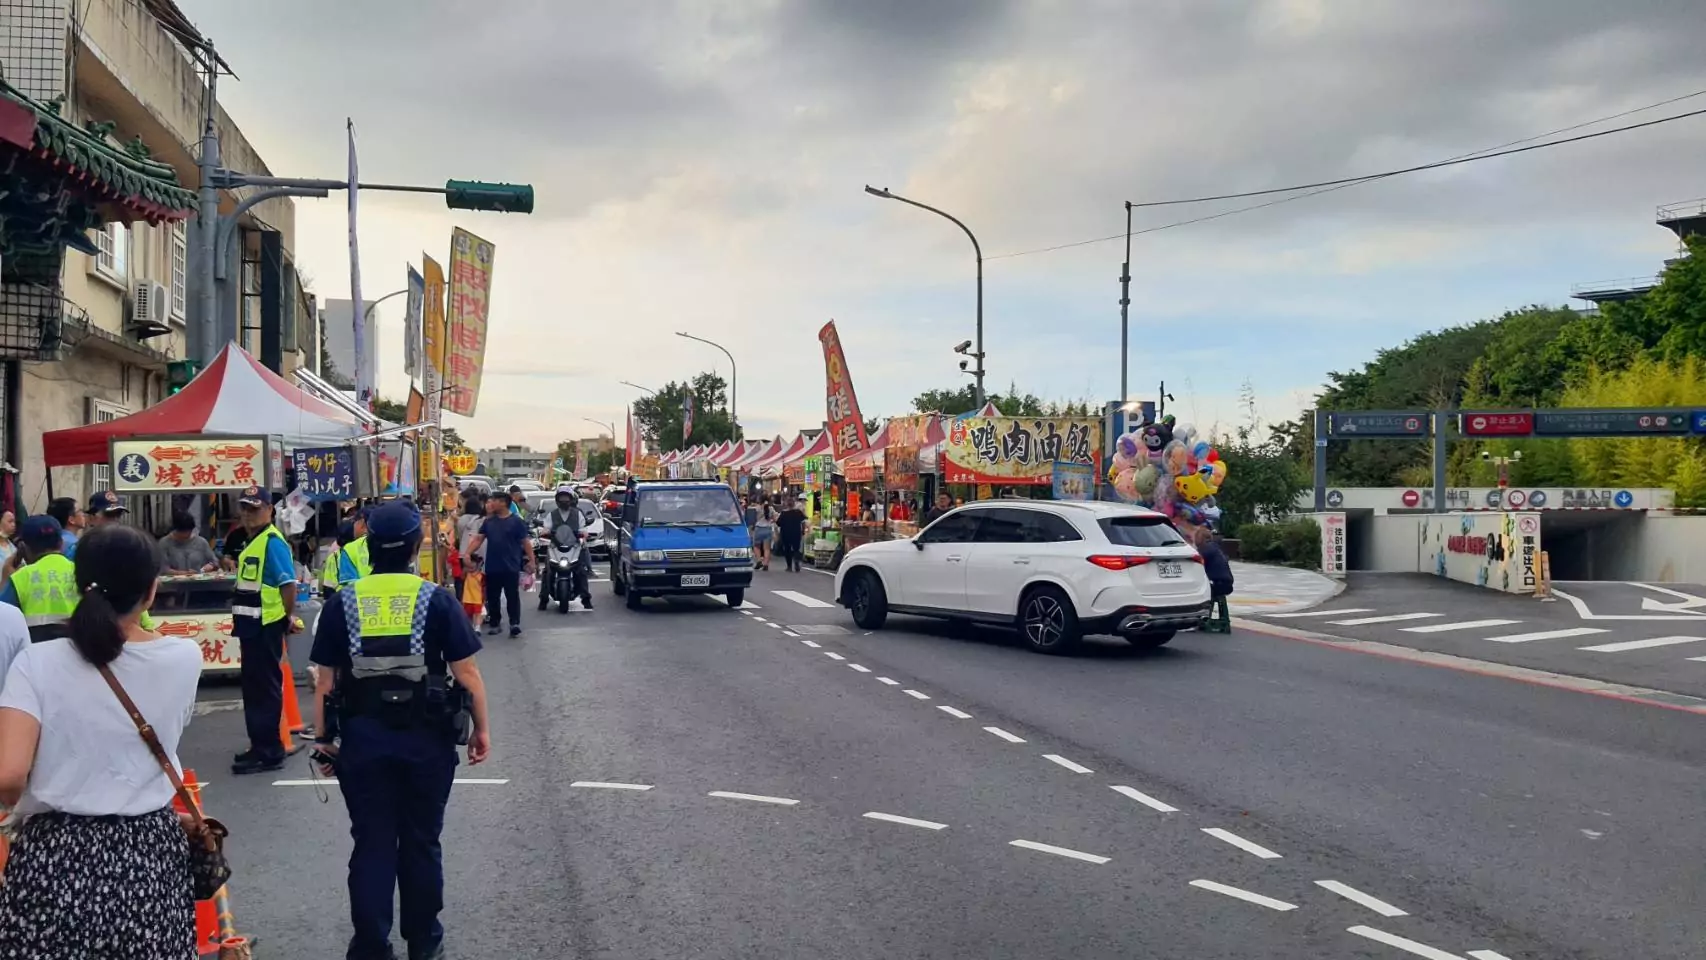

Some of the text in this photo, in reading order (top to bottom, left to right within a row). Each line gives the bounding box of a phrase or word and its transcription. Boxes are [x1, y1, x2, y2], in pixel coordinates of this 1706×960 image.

[970, 420, 1094, 466] 鴨肉油飯
[122, 454, 146, 482] 義
[155, 461, 257, 487] 烤魷魚
[310, 474, 353, 496] 小丸子
[1563, 489, 1611, 500] 汽車入口
[1326, 528, 1334, 572] 行人出入口
[1523, 535, 1536, 586] 車道出入口
[360, 593, 411, 617] 警察
